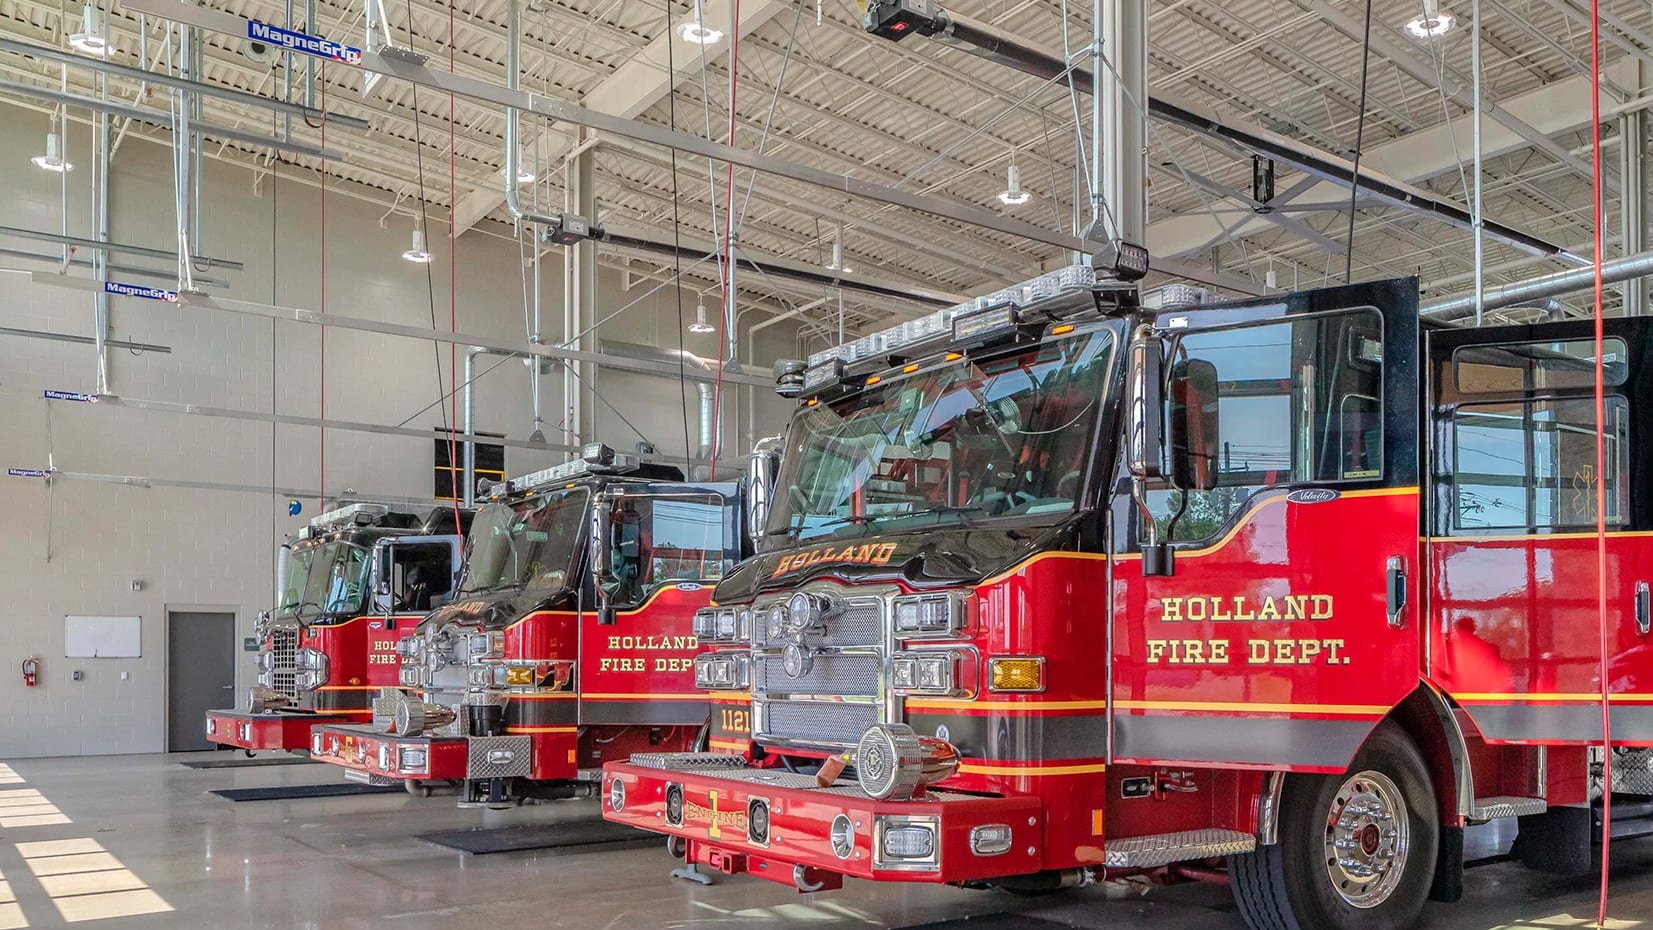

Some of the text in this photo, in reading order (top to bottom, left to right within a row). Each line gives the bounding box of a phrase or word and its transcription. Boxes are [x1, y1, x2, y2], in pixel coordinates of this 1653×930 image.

[252, 23, 361, 65] MagneGrip
[107, 283, 178, 302] MagneGrip
[771, 543, 898, 577] HOLLAND
[1161, 595, 1334, 621] HOLLAND
[608, 636, 698, 649] HOLLAND
[1146, 639, 1350, 664] FIRE DEPT.
[370, 654, 396, 664] FIRE
[600, 658, 696, 671] FIRE DEP
[721, 709, 750, 732] 1121
[686, 801, 746, 832] ENGINE
